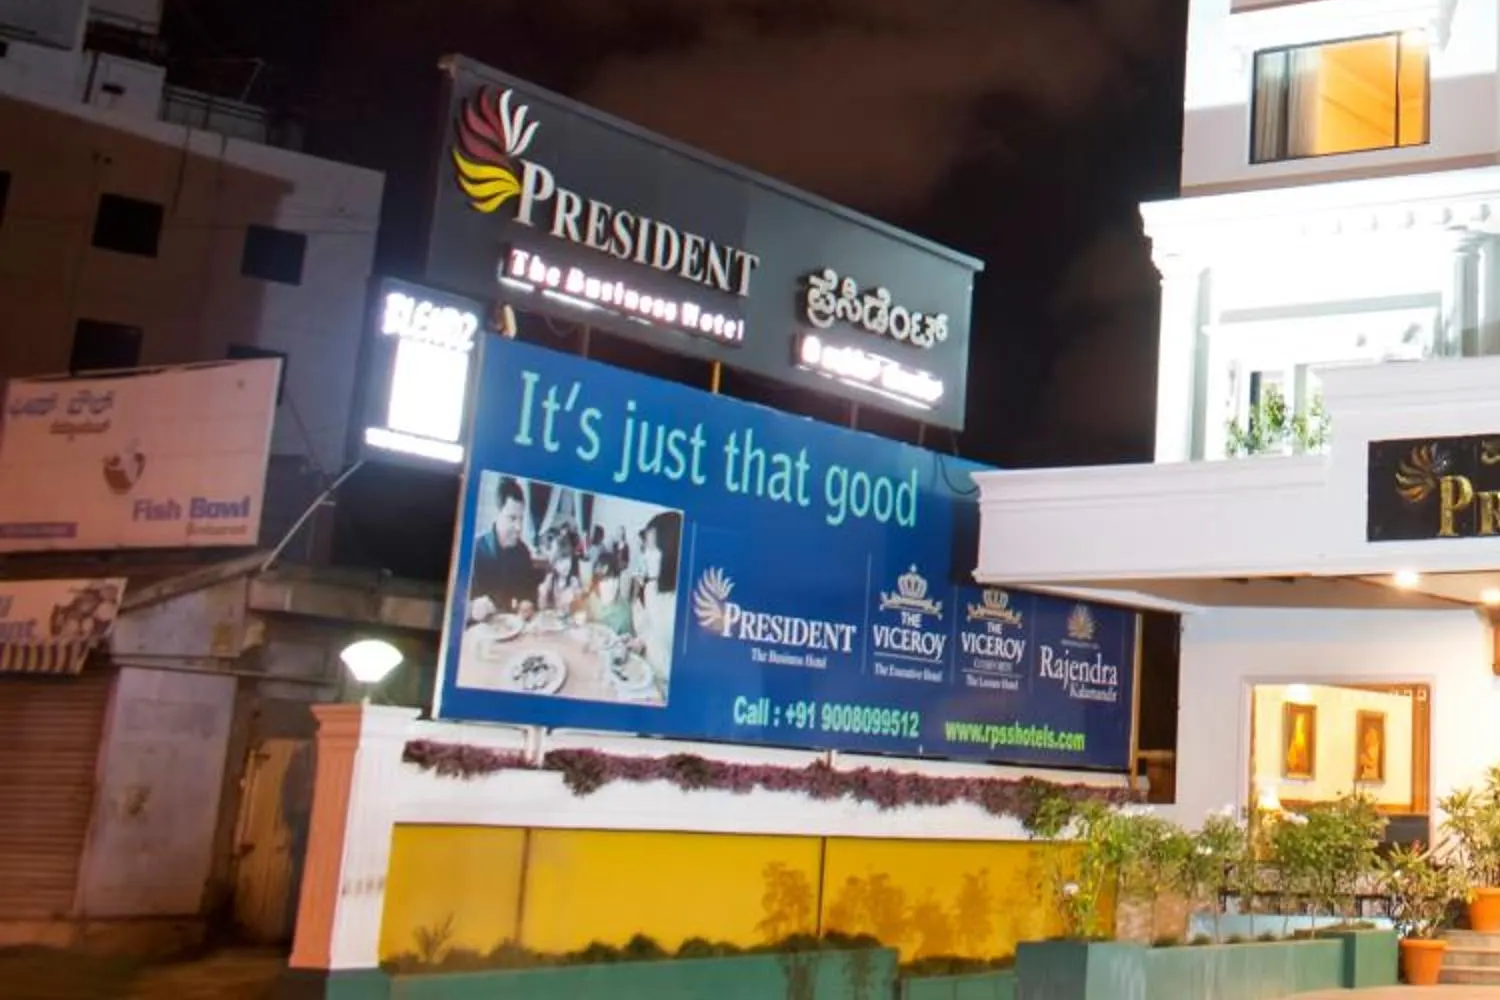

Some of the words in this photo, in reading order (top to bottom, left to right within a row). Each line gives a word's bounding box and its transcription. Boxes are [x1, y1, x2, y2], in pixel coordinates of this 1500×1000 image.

[512, 159, 761, 297] PRESIDENT
[508, 248, 561, 288] The
[564, 266, 678, 325] Business
[681, 301, 745, 342] Hotel
[514, 371, 602, 462] It's
[614, 400, 707, 484] just
[724, 428, 812, 507] that
[825, 463, 918, 528] good
[133, 499, 182, 521] Fish
[189, 496, 250, 519] Bowl
[721, 601, 857, 653] PRESIDENT
[901, 611, 922, 628] THE
[986, 621, 1003, 635] THE
[873, 625, 947, 659] VICEROY
[961, 632, 1026, 664] VICEROY
[1040, 646, 1118, 690] Rajendra
[734, 696, 770, 726] Call
[785, 701, 816, 729] +91
[821, 703, 920, 738] 9008099512
